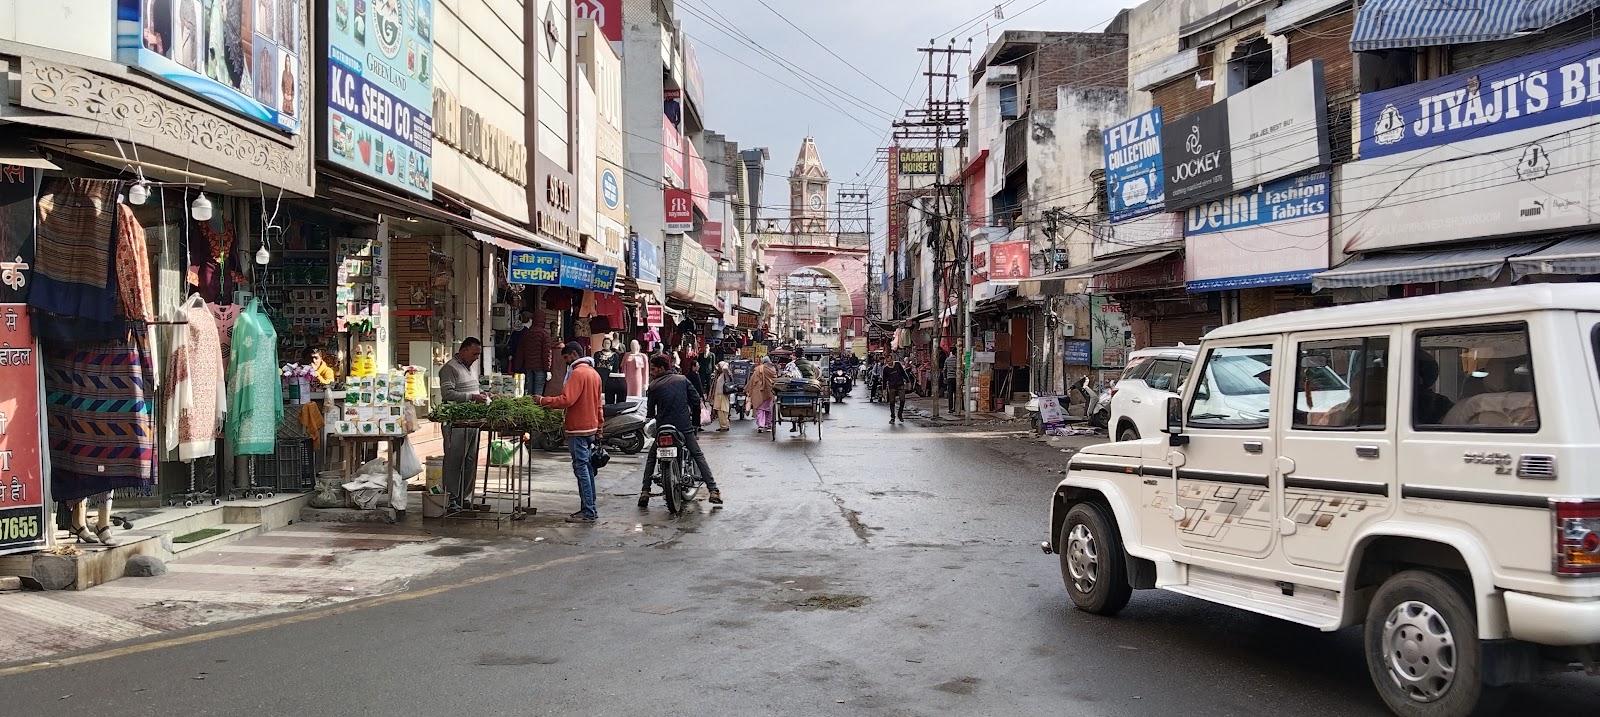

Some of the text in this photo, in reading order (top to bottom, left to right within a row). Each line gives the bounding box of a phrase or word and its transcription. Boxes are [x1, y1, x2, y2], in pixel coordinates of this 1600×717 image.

[331, 65, 359, 115] K.C.
[361, 83, 392, 130] SEED
[395, 102, 413, 142] CO.
[1413, 70, 1549, 137] JIYAJI'S
[1109, 113, 1156, 152] FIZA
[1283, 117, 1294, 127] BUY
[903, 162, 928, 173] HOUSE
[1108, 136, 1161, 172] COLLECTION
[1171, 150, 1221, 184] JOCKEY
[549, 174, 572, 212] SETHI
[1265, 183, 1325, 205] Fashion
[1272, 198, 1325, 220] Fabrics
[1520, 207, 1541, 217] PUMA
[0, 515, 38, 540] 7655
